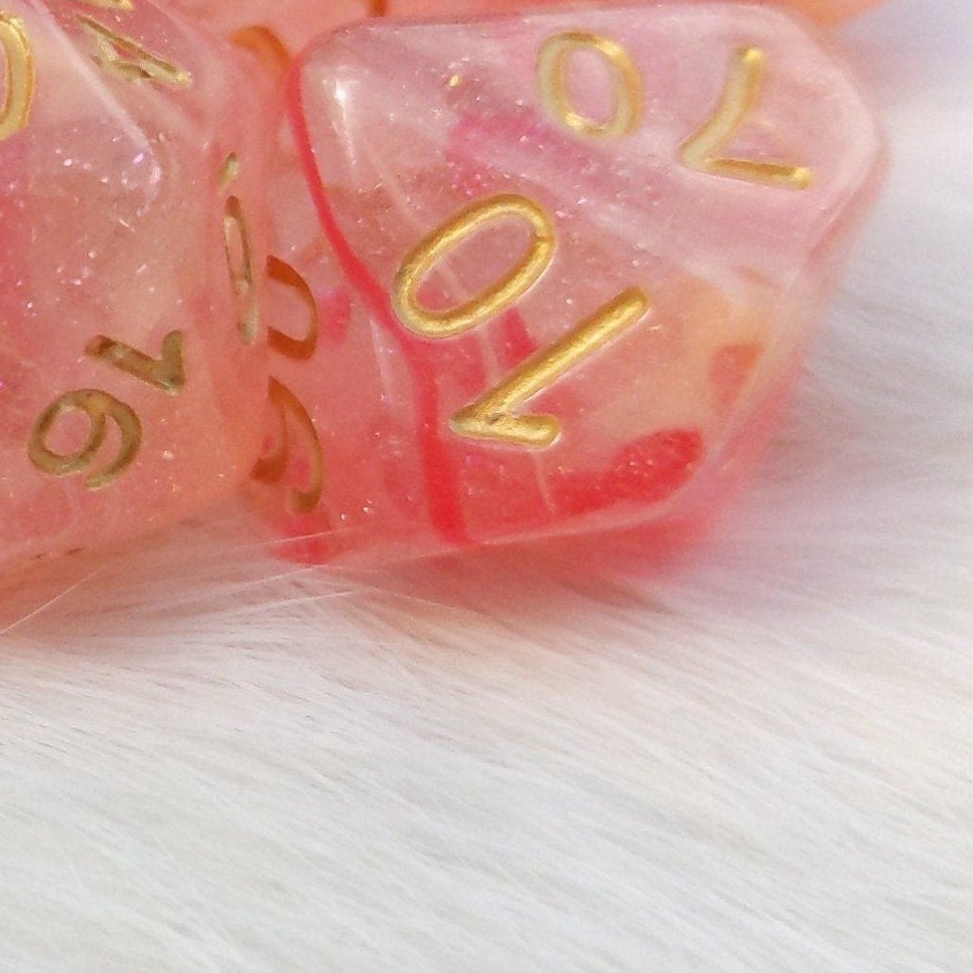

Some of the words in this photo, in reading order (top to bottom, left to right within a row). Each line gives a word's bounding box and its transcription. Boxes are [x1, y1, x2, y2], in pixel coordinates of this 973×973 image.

[538, 31, 814, 191] 70
[393, 193, 649, 451] 10
[28, 330, 187, 491] 16
